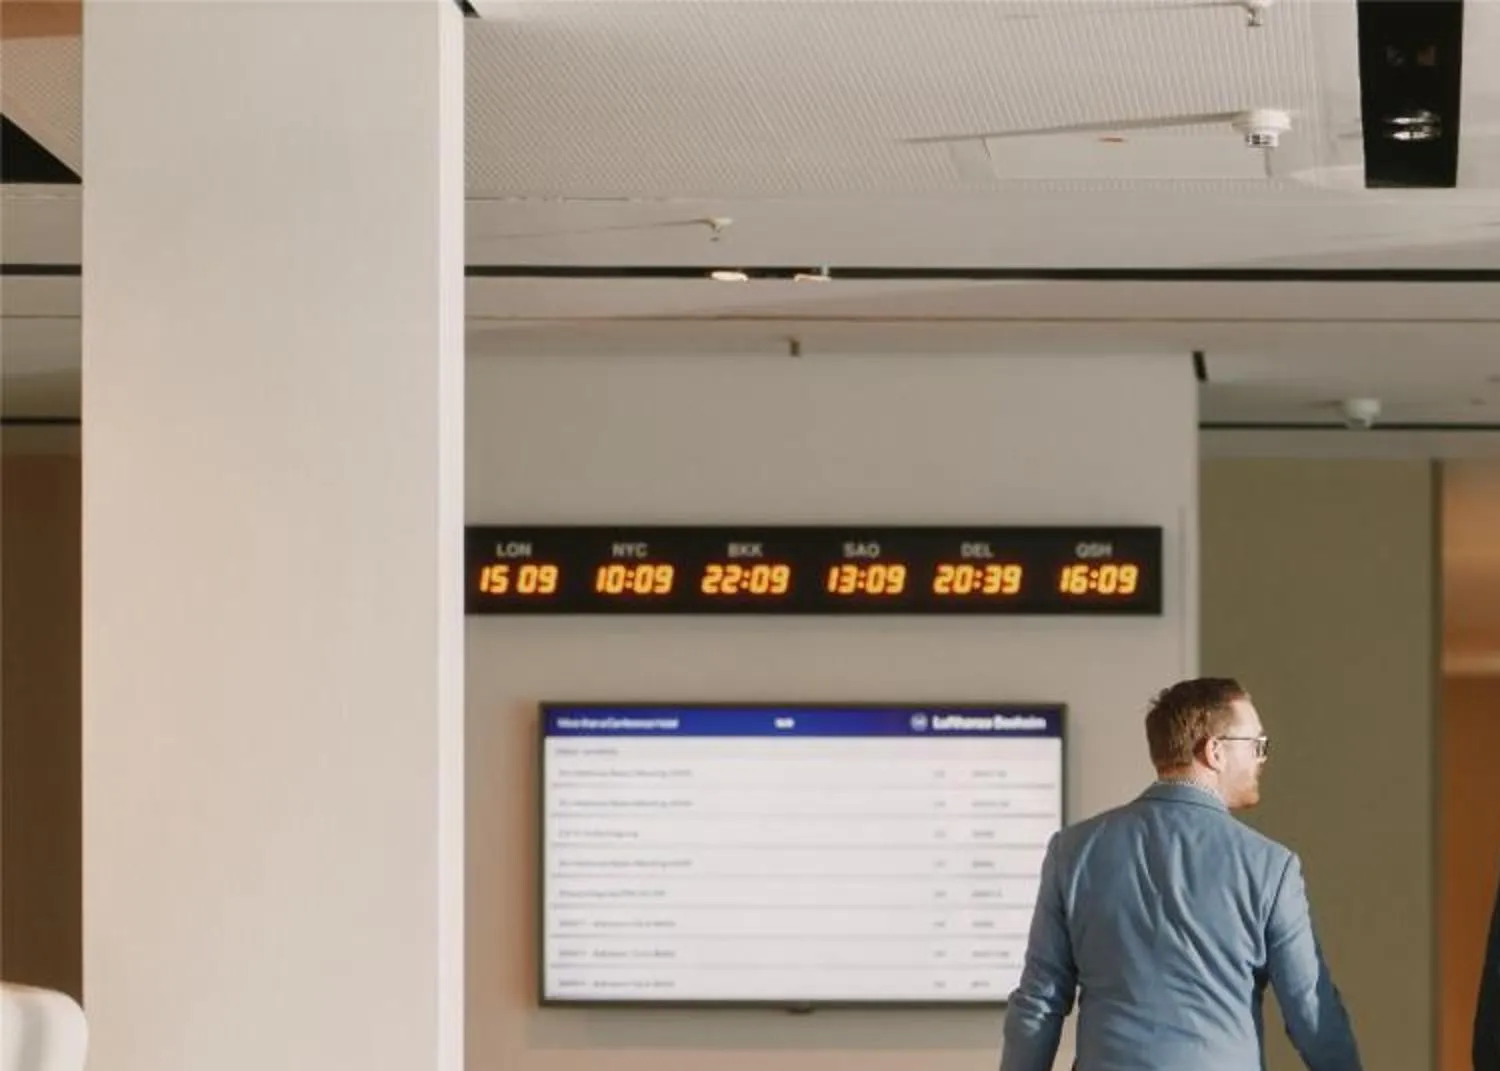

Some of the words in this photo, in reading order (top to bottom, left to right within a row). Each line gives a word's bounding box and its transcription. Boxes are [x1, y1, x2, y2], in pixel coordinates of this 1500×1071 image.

[496, 542, 532, 558] LON
[612, 543, 647, 558] NYC
[727, 543, 763, 558] BKK
[595, 564, 674, 594] 10:09
[701, 564, 790, 594] 22:09
[827, 564, 907, 594] 13:09
[933, 564, 1023, 594] 20:39
[1059, 564, 1139, 594] 16:09
